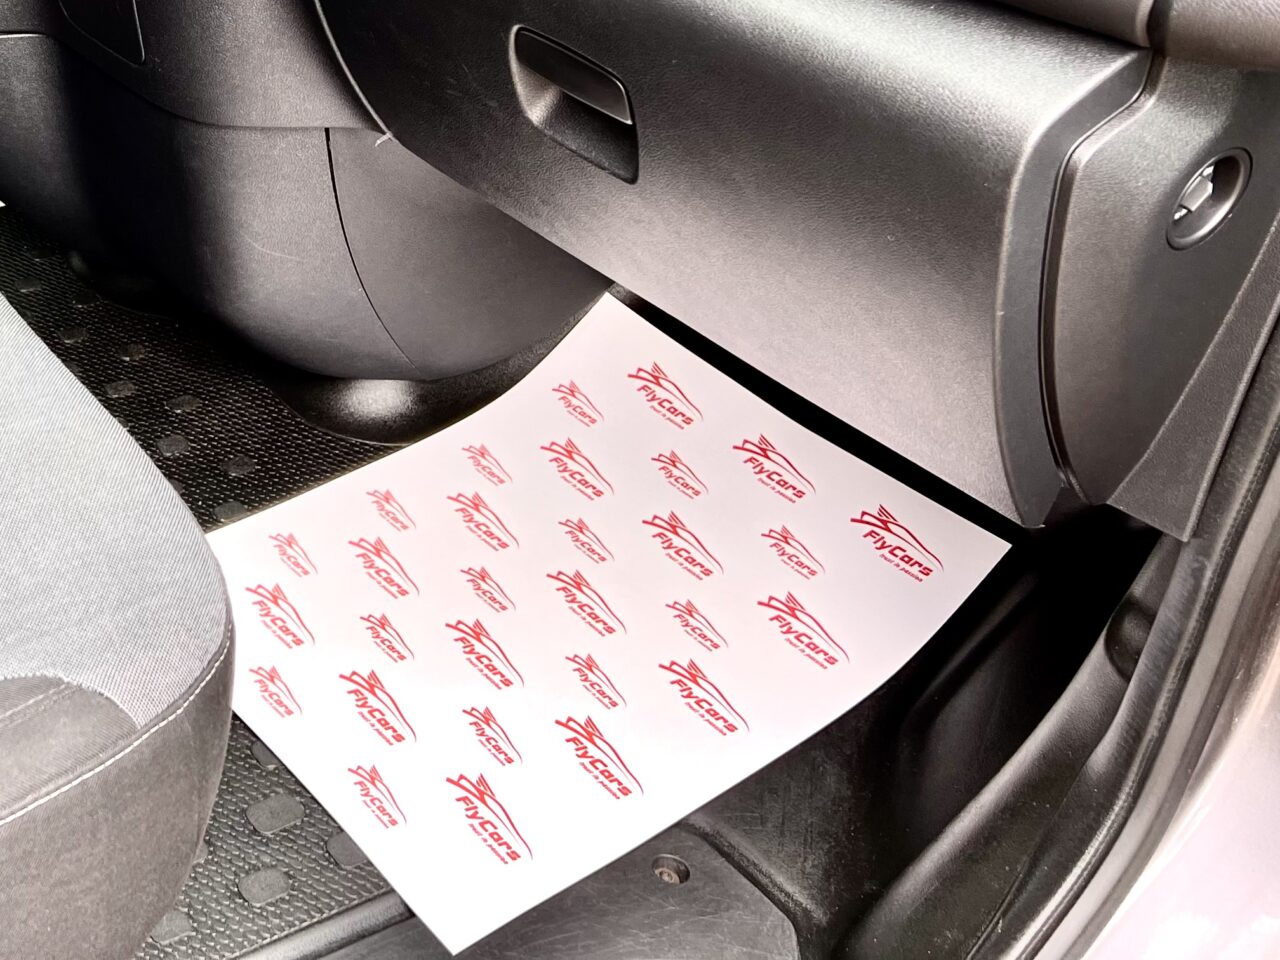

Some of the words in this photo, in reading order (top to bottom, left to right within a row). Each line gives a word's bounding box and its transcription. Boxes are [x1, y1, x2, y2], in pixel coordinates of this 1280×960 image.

[637, 384, 694, 425] FlyCars
[549, 456, 604, 497] FlyCars
[658, 465, 701, 497] FlyCars
[743, 456, 806, 499] FlyCars
[455, 507, 509, 549] FlyCars
[565, 530, 607, 562] FlyCars
[355, 553, 409, 596] FlyCars
[652, 532, 713, 577] FlyCars
[769, 542, 818, 576] FlyCars
[863, 530, 933, 577] FlyCars
[466, 578, 508, 611] FlyCars
[556, 586, 616, 634] FlyCars
[252, 600, 304, 646] FlyCars
[366, 626, 406, 661] FlyCars
[673, 614, 720, 649] FlyCars
[769, 614, 838, 665] FlyCars
[454, 636, 513, 686] FlyCars
[573, 667, 619, 707] FlyCars
[670, 679, 738, 733] FlyCars
[347, 689, 405, 742] FlyCars
[469, 721, 514, 764] FlyCars
[565, 737, 632, 796] FlyCars
[354, 780, 398, 826] FlyCars
[455, 796, 521, 861] FlyCars
